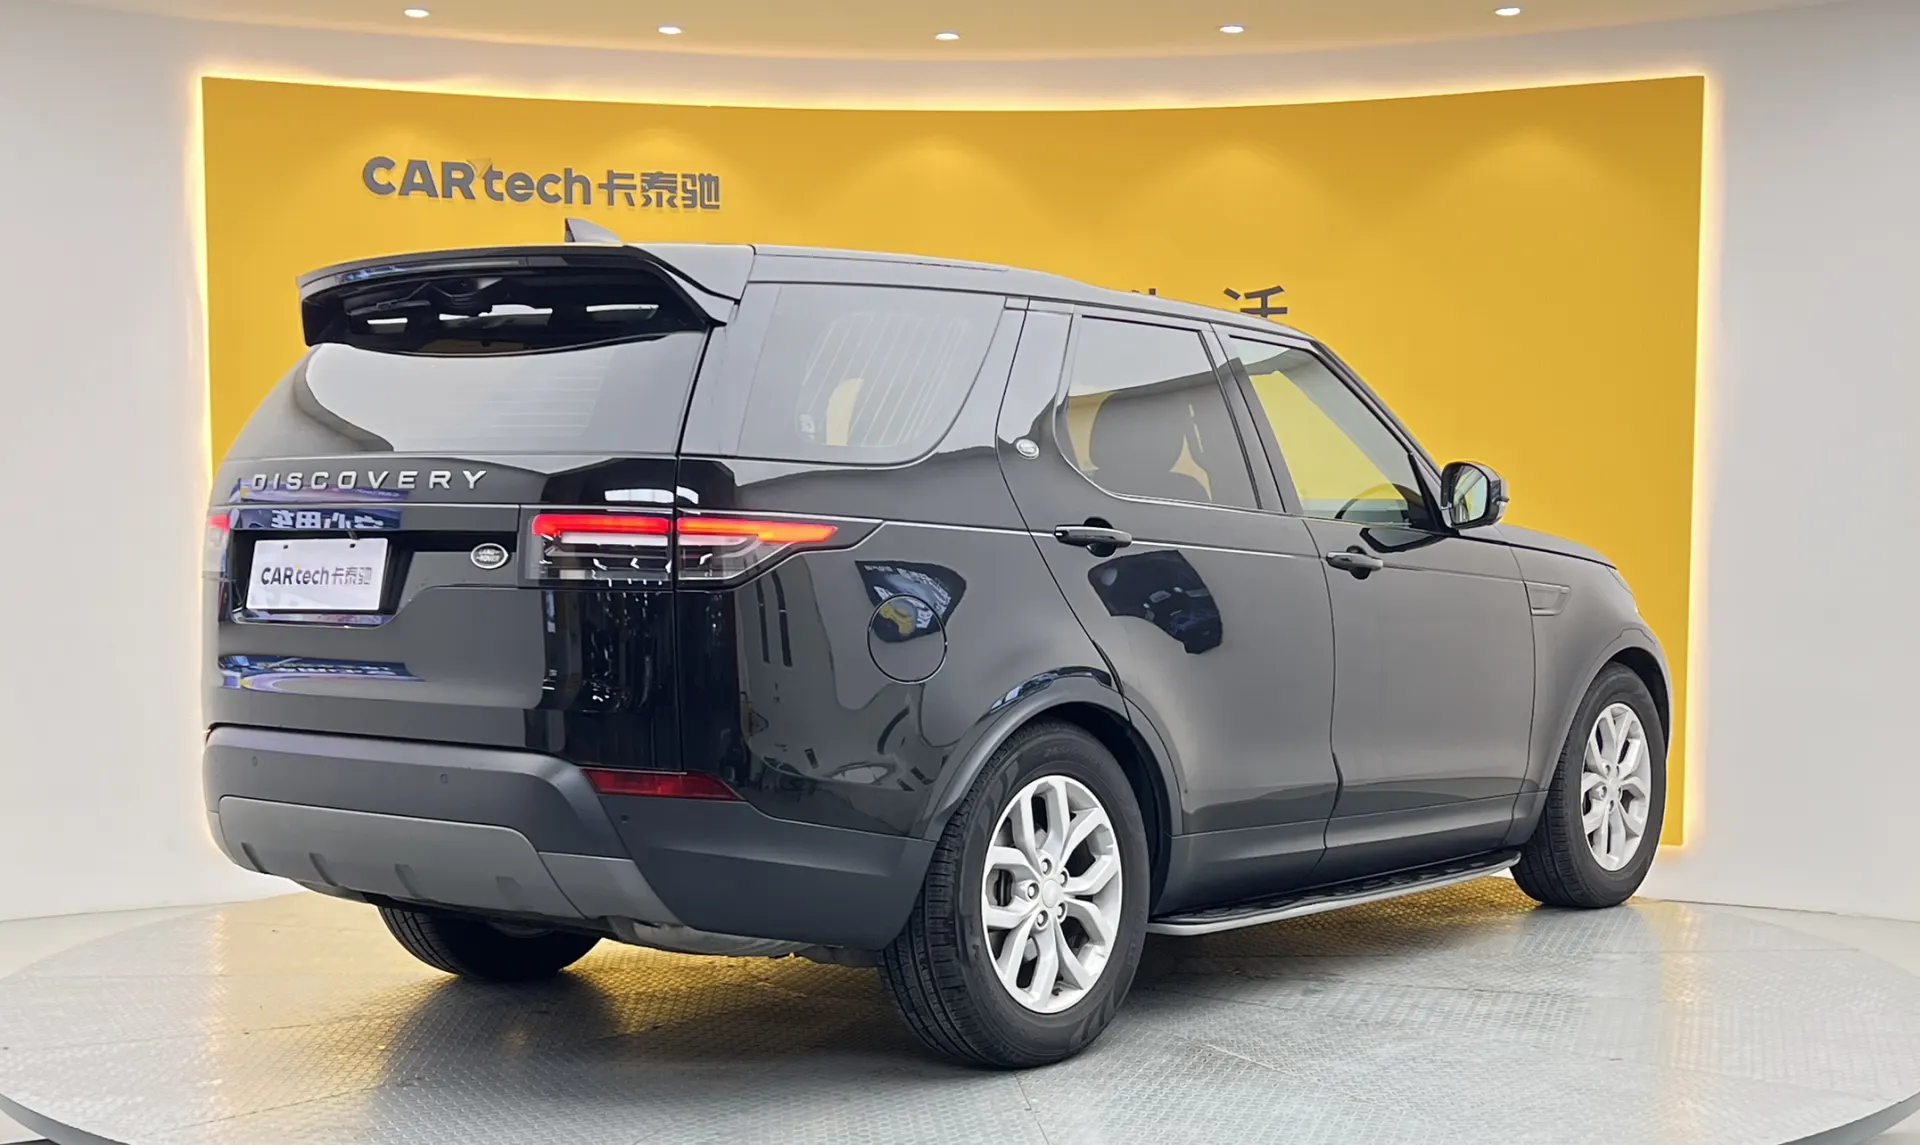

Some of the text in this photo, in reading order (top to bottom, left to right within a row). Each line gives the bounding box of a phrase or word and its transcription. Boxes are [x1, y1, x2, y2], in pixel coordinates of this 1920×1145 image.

[362, 156, 721, 210] CARtech 卡泰驰
[251, 470, 487, 491] DISCOVERY
[261, 566, 373, 586] CARtech 卡泰驰
